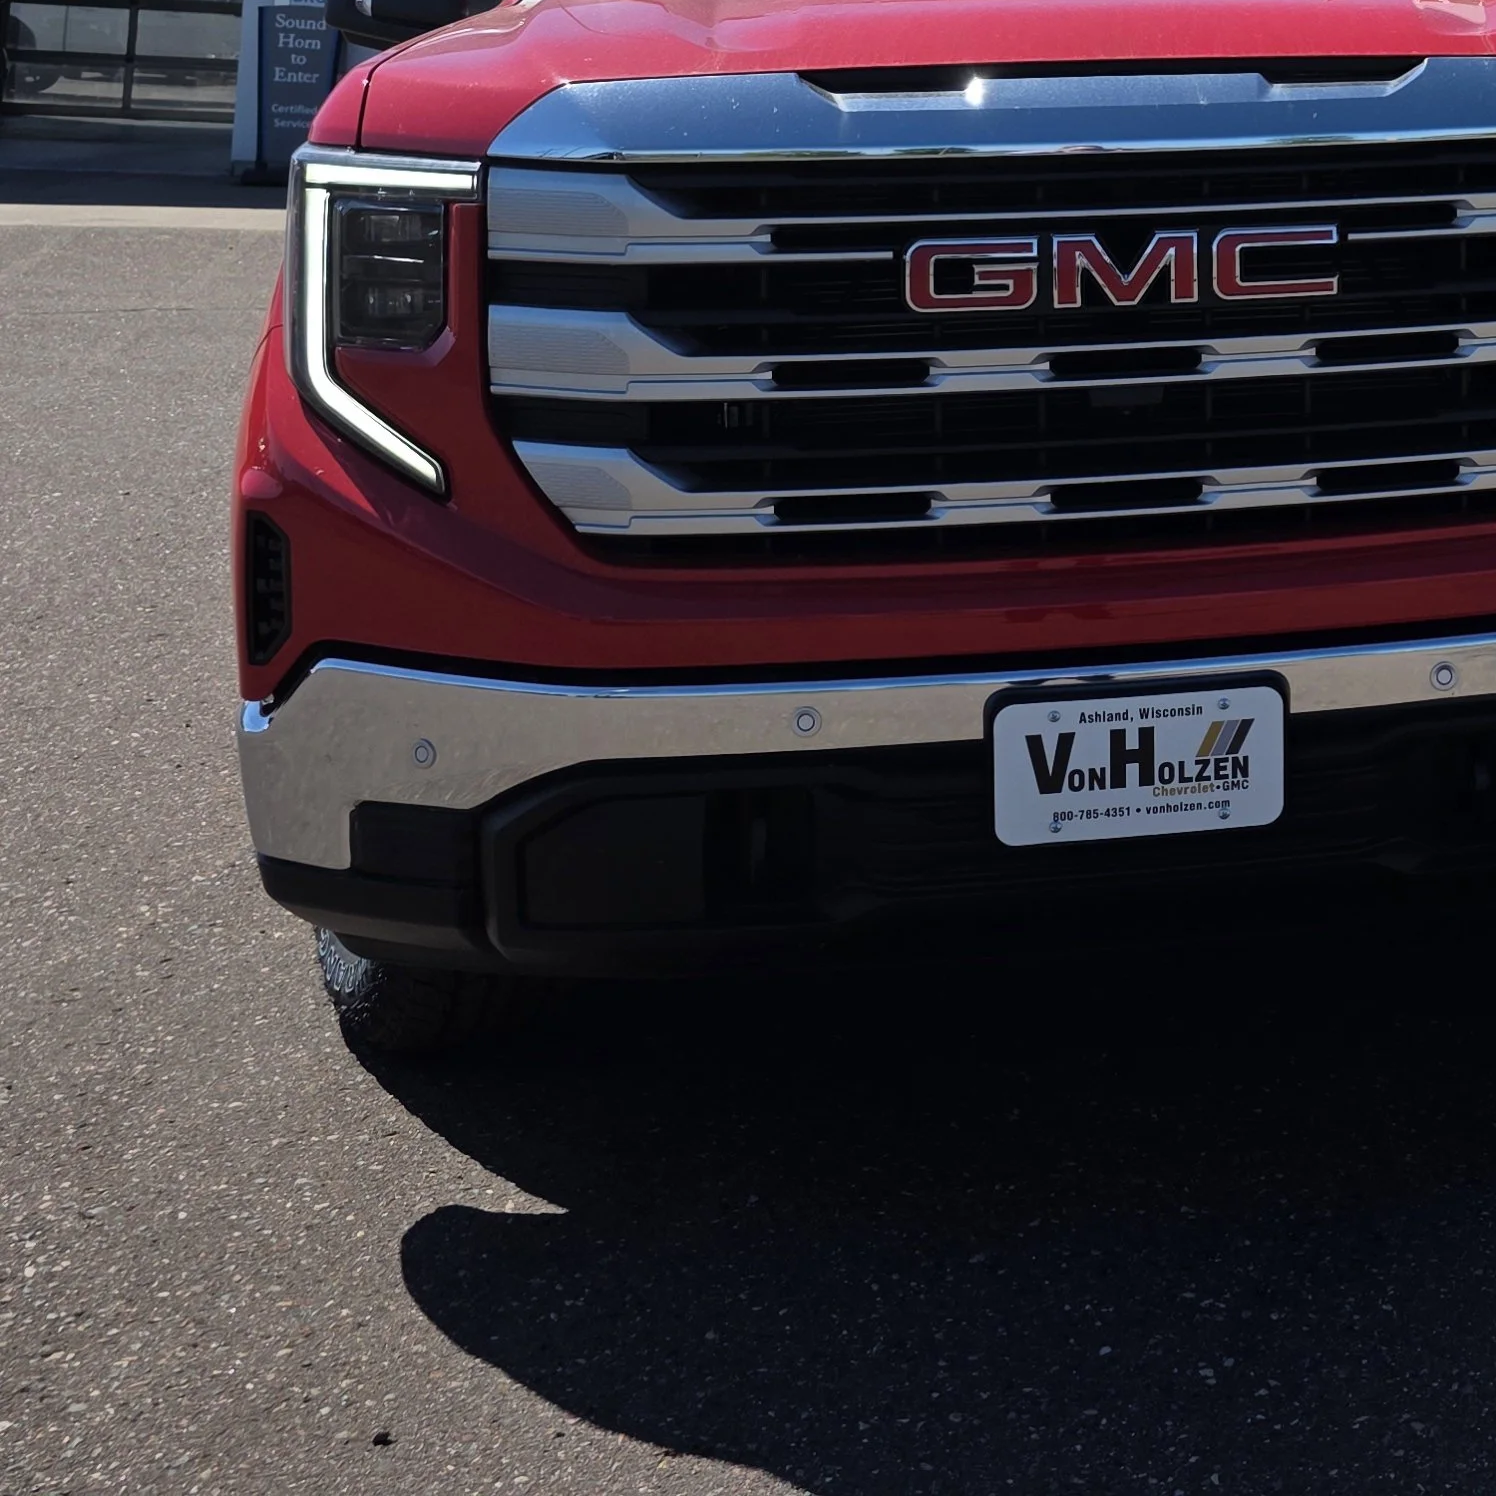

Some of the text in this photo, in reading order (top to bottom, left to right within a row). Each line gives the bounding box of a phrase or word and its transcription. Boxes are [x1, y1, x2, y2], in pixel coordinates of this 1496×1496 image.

[275, 13, 327, 31] Sound
[277, 32, 321, 50] Horn
[291, 54, 308, 65] to
[273, 67, 320, 83] Enter
[904, 223, 1338, 313] GMC
[1078, 703, 1203, 724] Ashland, Wisconsin
[1052, 799, 1231, 822] 800-785-4351 vonholzen.com
